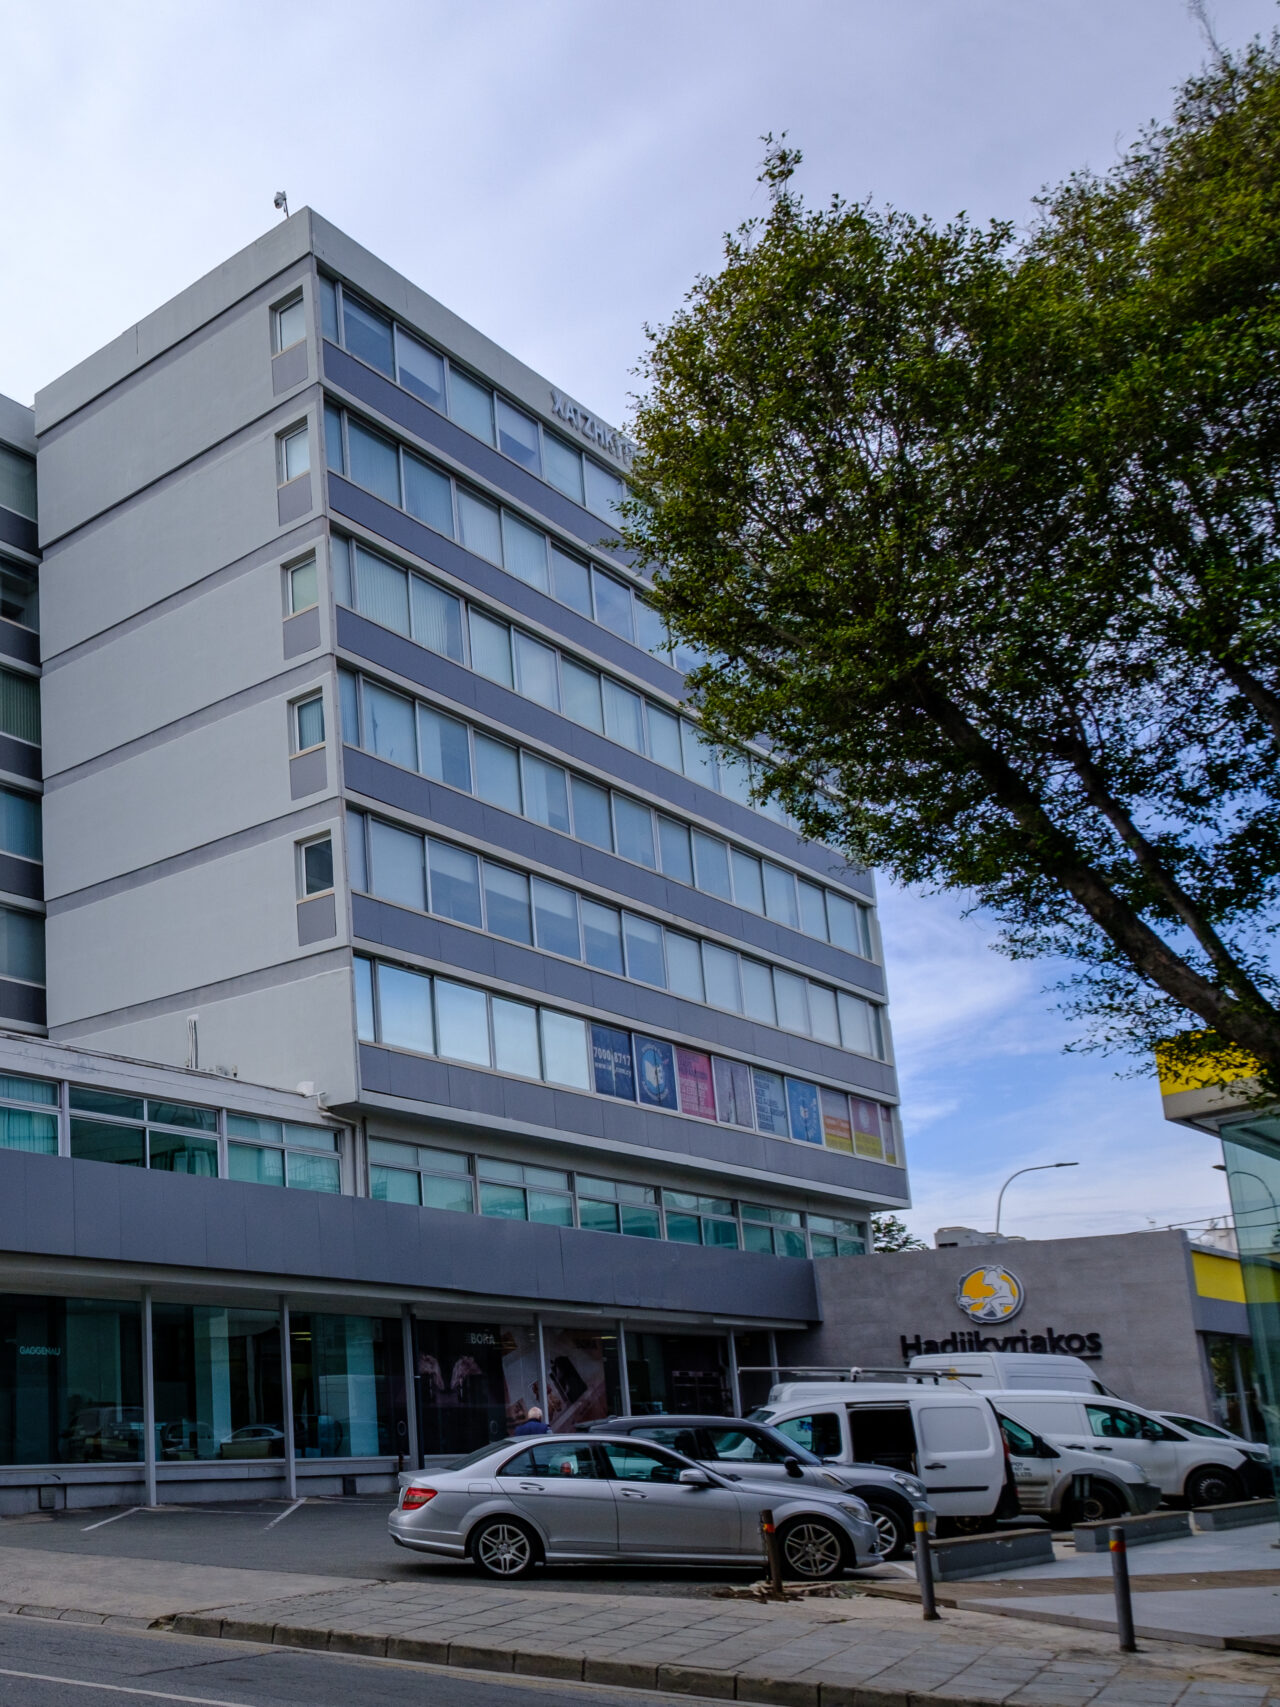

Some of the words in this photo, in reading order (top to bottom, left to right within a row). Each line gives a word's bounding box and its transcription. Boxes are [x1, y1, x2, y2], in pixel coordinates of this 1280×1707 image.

[593, 1047, 611, 1062] 7000
[470, 1333, 495, 1345] BORA
[19, 1345, 61, 1355] GAGGENAU
